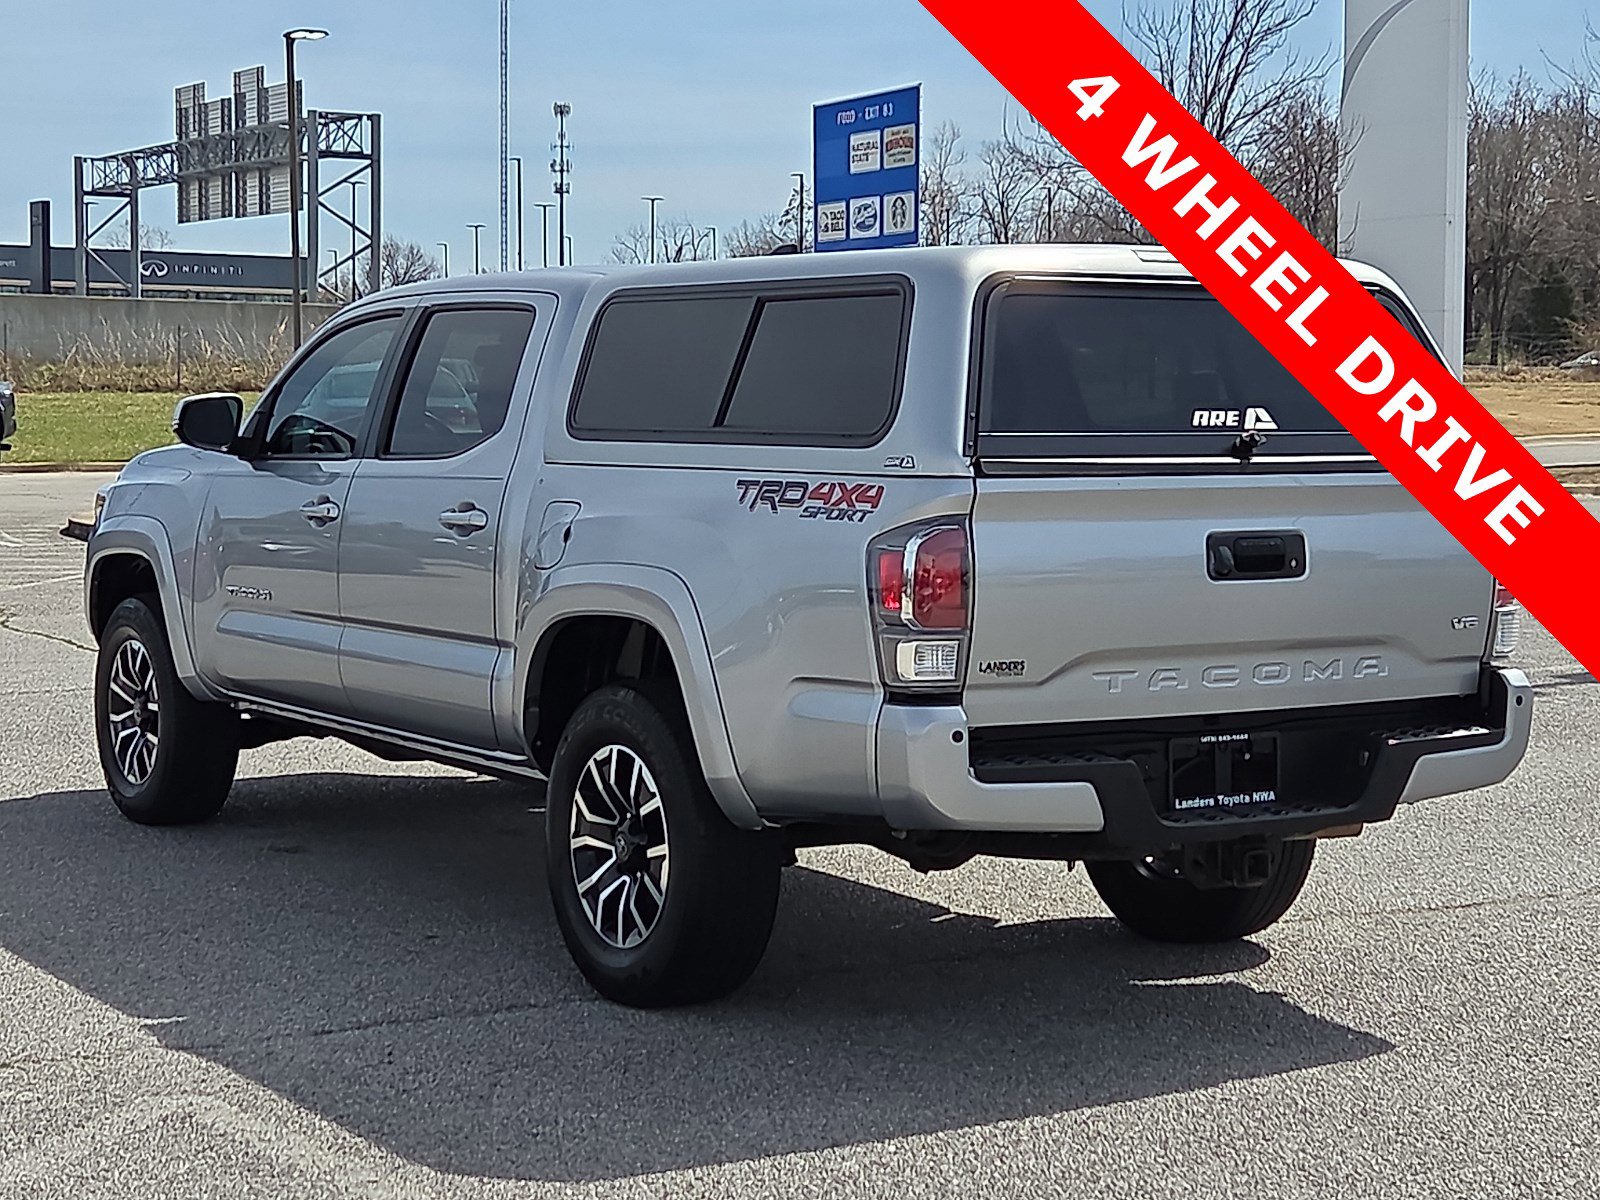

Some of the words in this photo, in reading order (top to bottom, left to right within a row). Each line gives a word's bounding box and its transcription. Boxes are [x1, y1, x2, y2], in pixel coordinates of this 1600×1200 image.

[829, 210, 845, 221] TACO
[173, 264, 244, 276] INFINITI
[1192, 410, 1240, 427] ARE
[736, 480, 809, 514] TRD
[800, 505, 875, 523] SPORT
[979, 660, 1026, 673] LANDERS
[1092, 655, 1389, 693] TACOMA
[1175, 797, 1215, 810] Landers
[1217, 793, 1251, 807] Toyota
[1252, 790, 1276, 803] NWA
